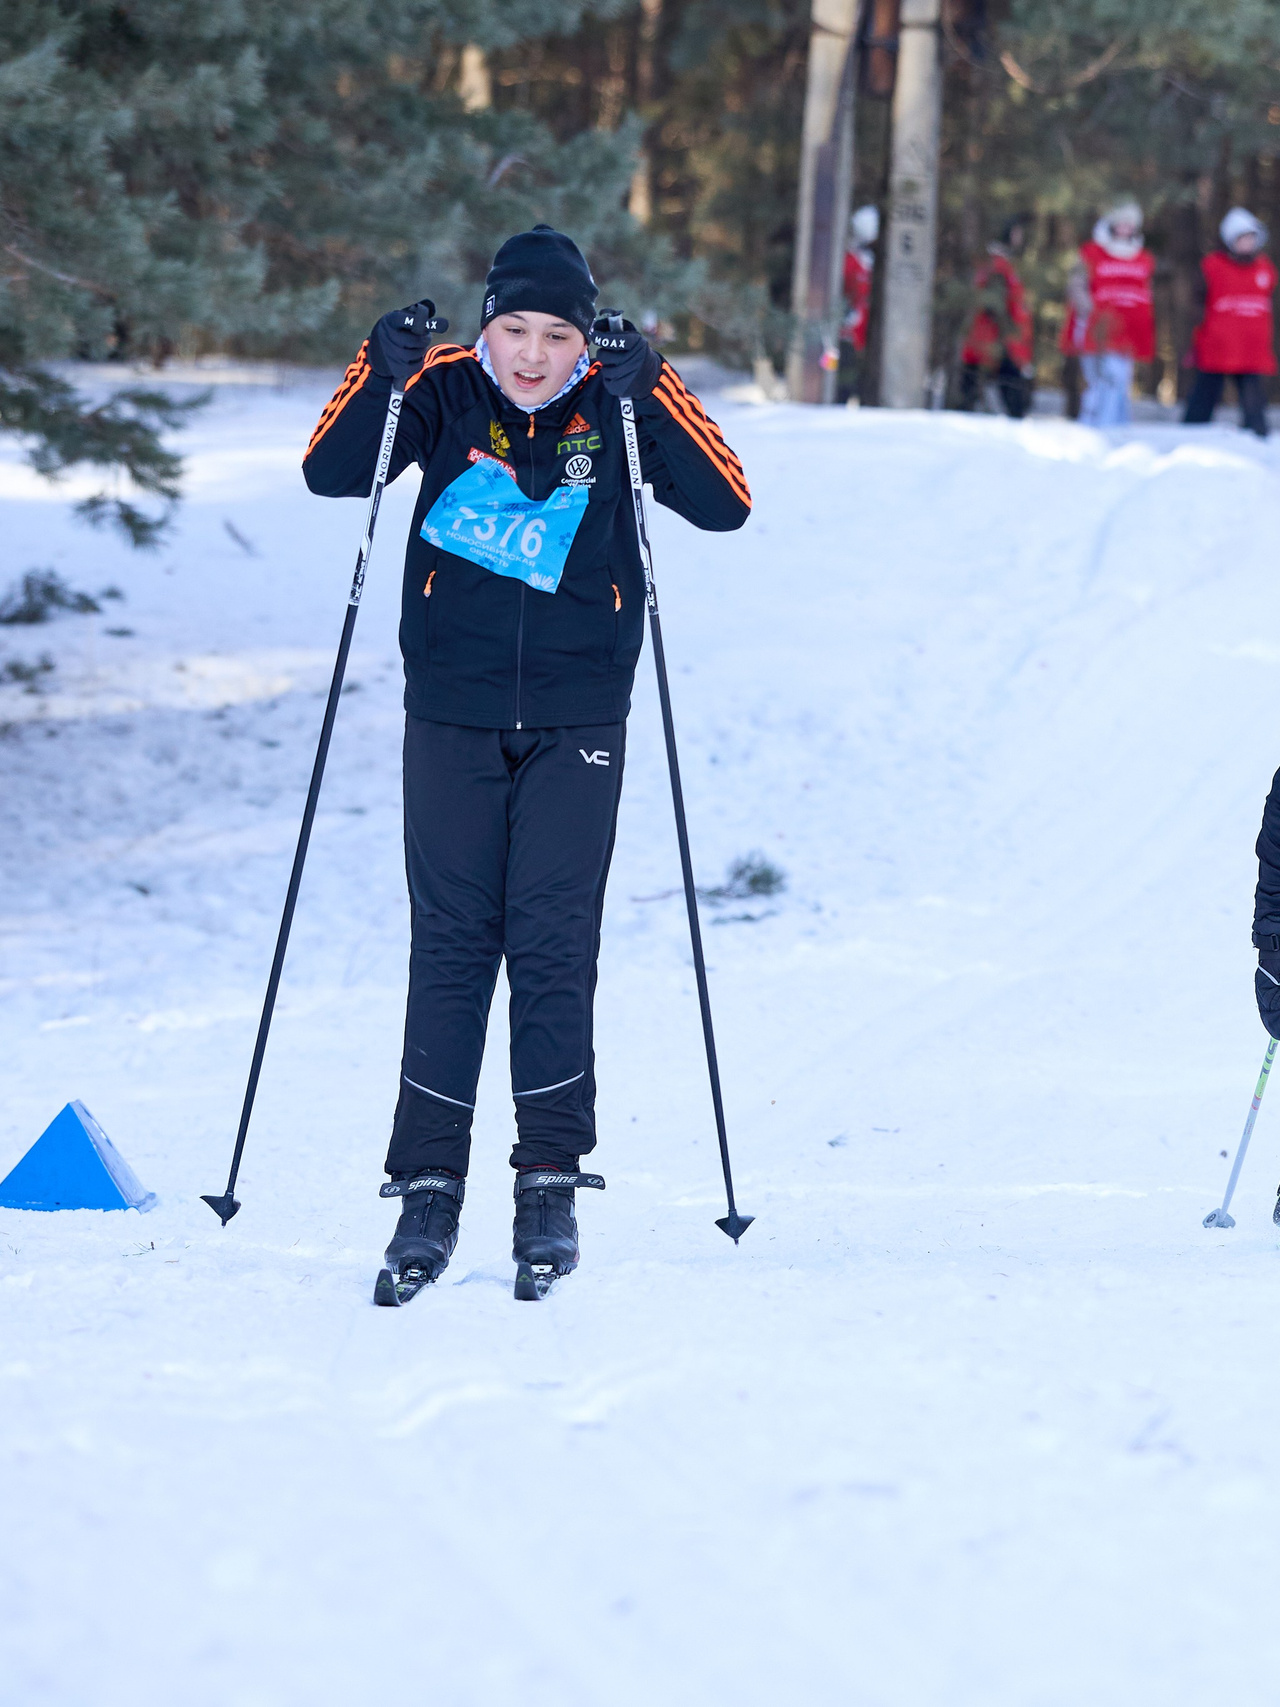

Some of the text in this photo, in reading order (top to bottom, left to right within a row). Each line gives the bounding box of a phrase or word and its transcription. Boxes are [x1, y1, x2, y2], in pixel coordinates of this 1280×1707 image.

[404, 317, 437, 330] MAX
[379, 418, 396, 478] NORDWAY
[626, 425, 641, 484] NORDWAY
[451, 506, 547, 558] 7376
[446, 530, 536, 568] НОВОСИБИРСКАЯ
[469, 547, 509, 568] ОБЛАСТЬ
[408, 1175, 448, 1191] spine
[536, 1173, 578, 1186] spine
